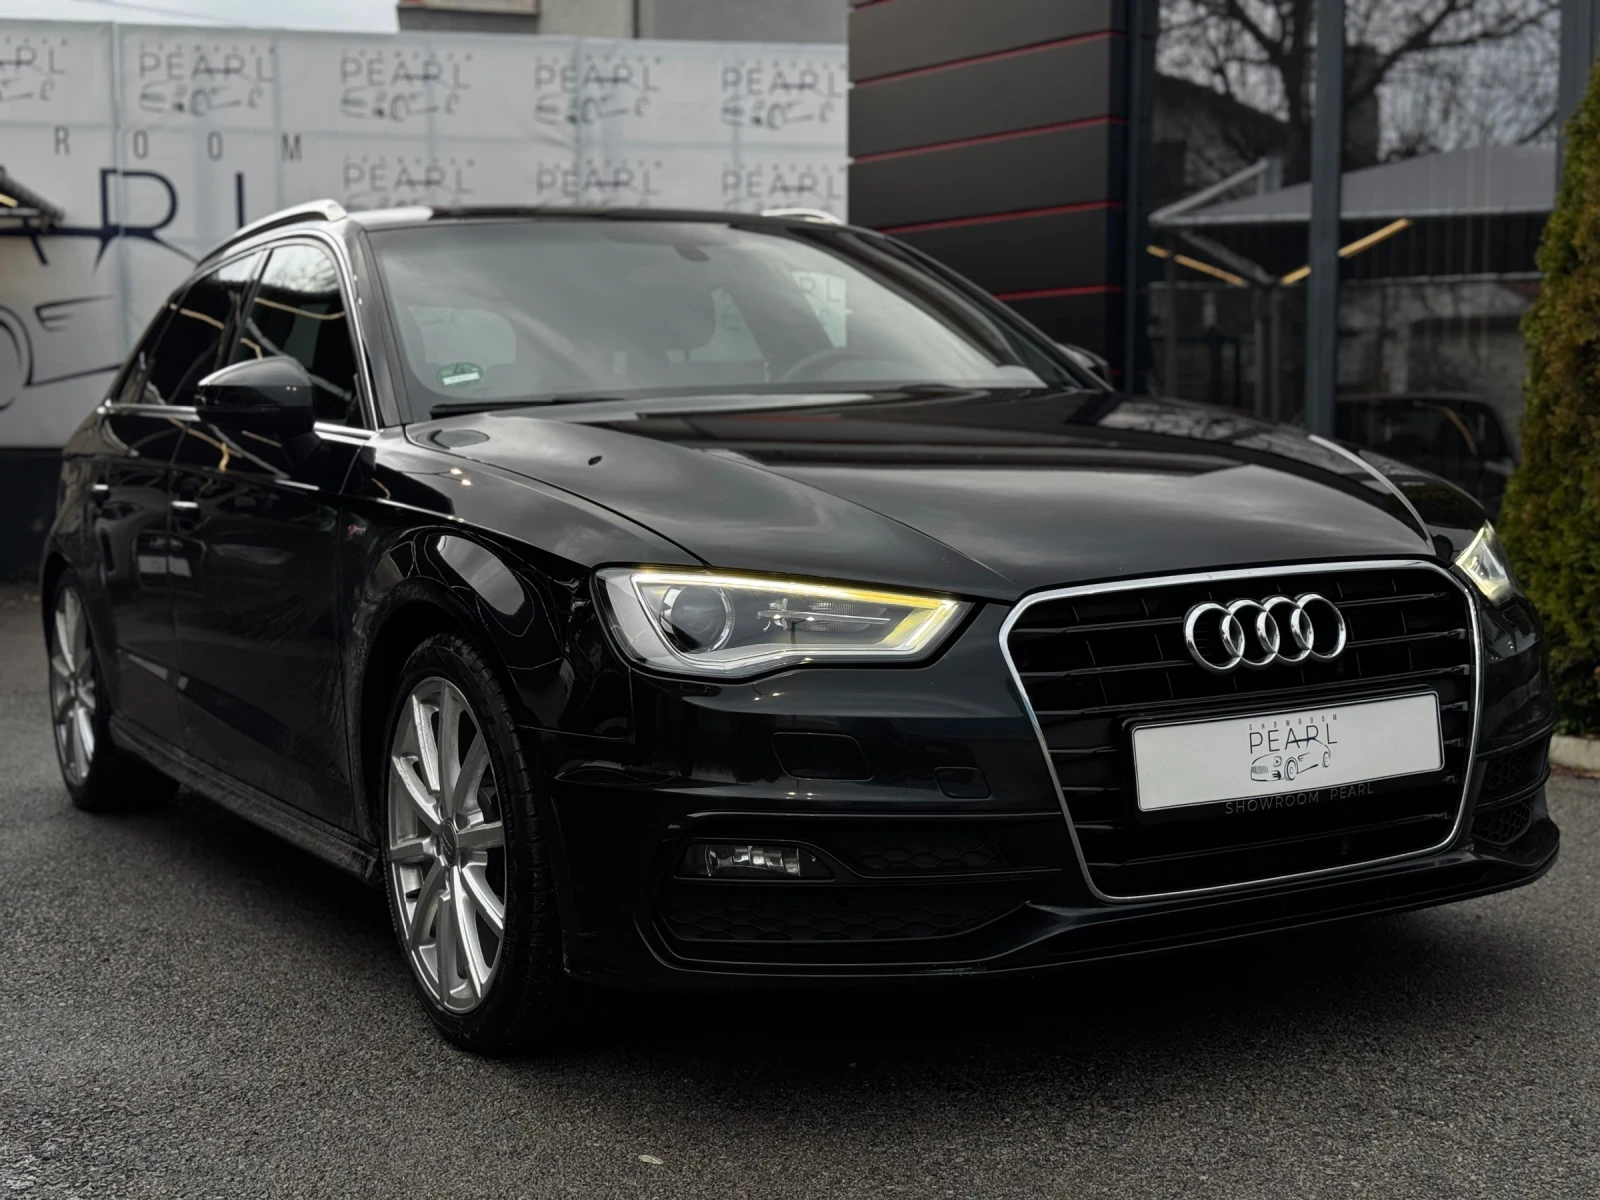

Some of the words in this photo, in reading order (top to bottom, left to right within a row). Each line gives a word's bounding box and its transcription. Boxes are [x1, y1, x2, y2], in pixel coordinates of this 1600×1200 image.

[0, 46, 66, 75] RL
[139, 51, 276, 83] PEARL
[340, 56, 471, 90] PEARL
[534, 63, 659, 93] PEARL
[722, 66, 843, 98] PEARL
[343, 162, 474, 194] PEARL
[536, 166, 660, 197] PEARL
[722, 169, 842, 201] PEARL
[1249, 723, 1338, 755] PEARL
[1225, 791, 1319, 814] SHOWROOM
[1330, 783, 1374, 801] PEARL
